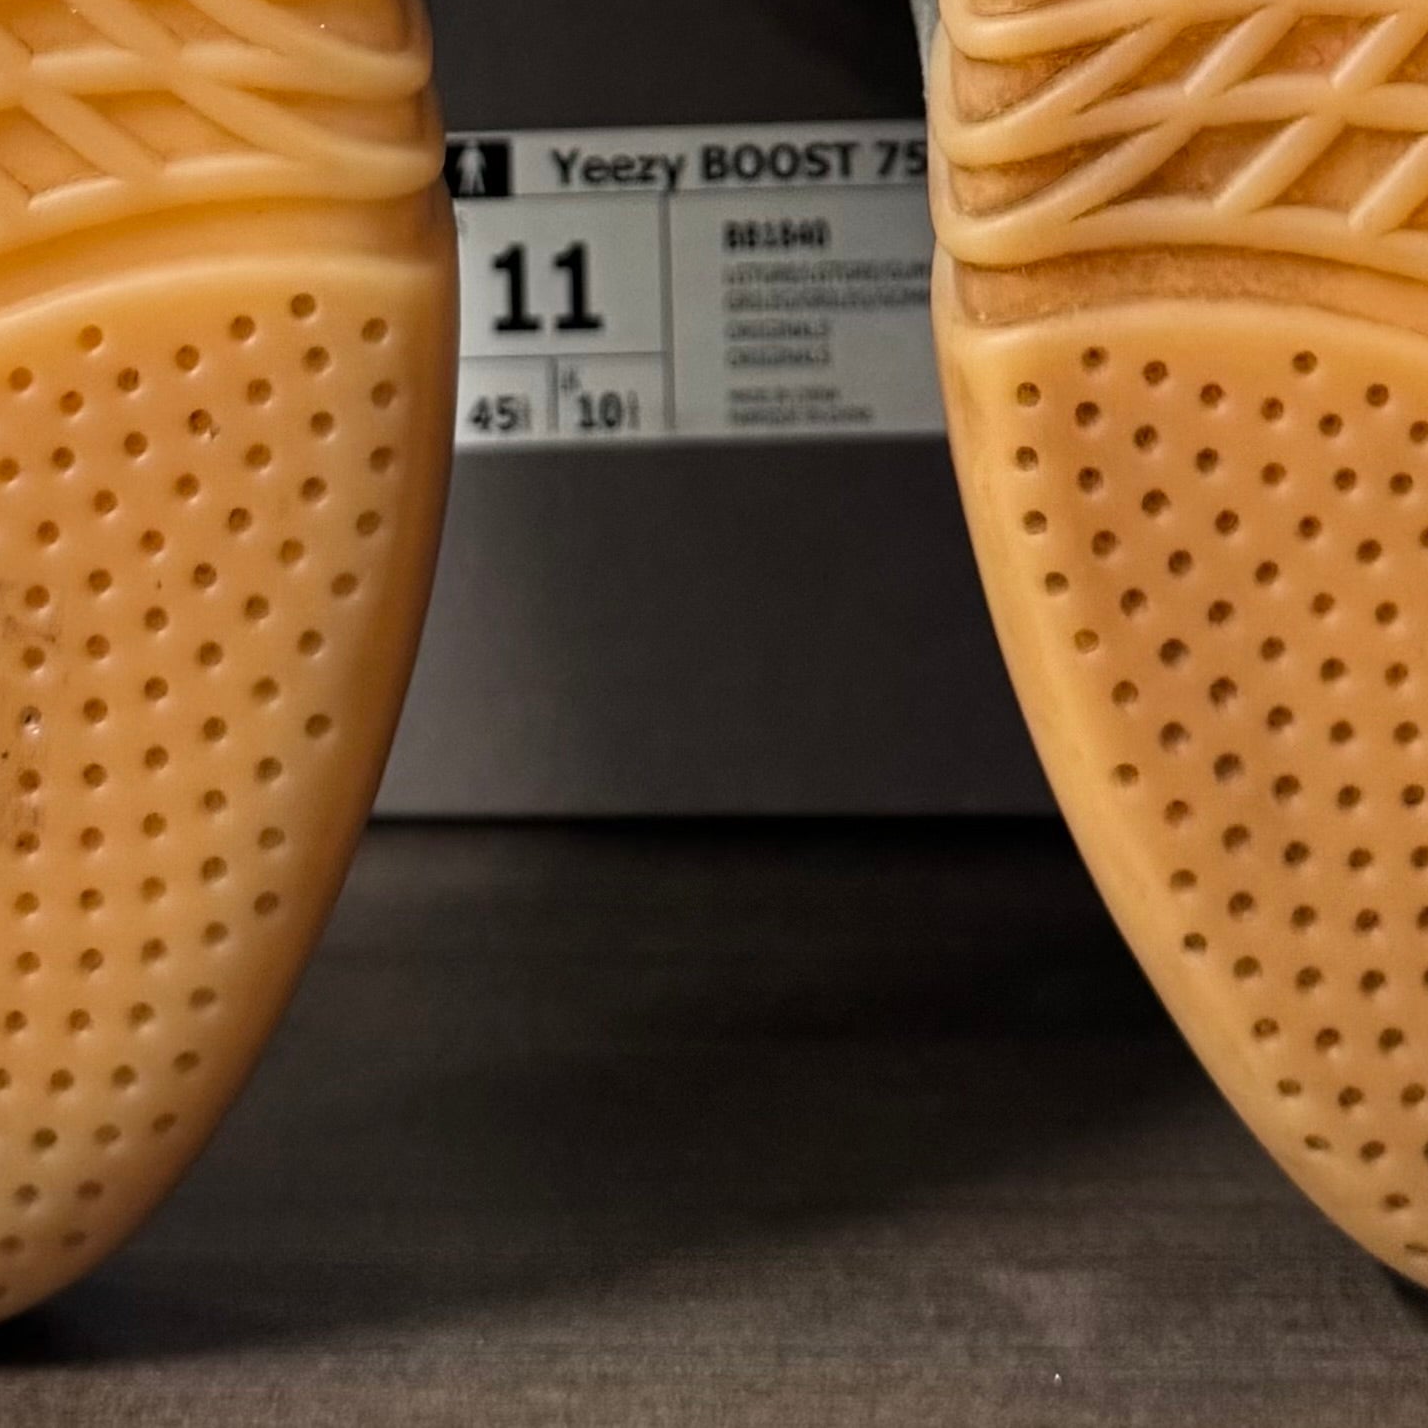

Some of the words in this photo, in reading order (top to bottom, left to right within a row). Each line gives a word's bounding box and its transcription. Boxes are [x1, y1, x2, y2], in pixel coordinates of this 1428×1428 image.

[552, 147, 685, 192] Yeezy
[700, 142, 858, 182] BOOST
[491, 240, 604, 332] 11
